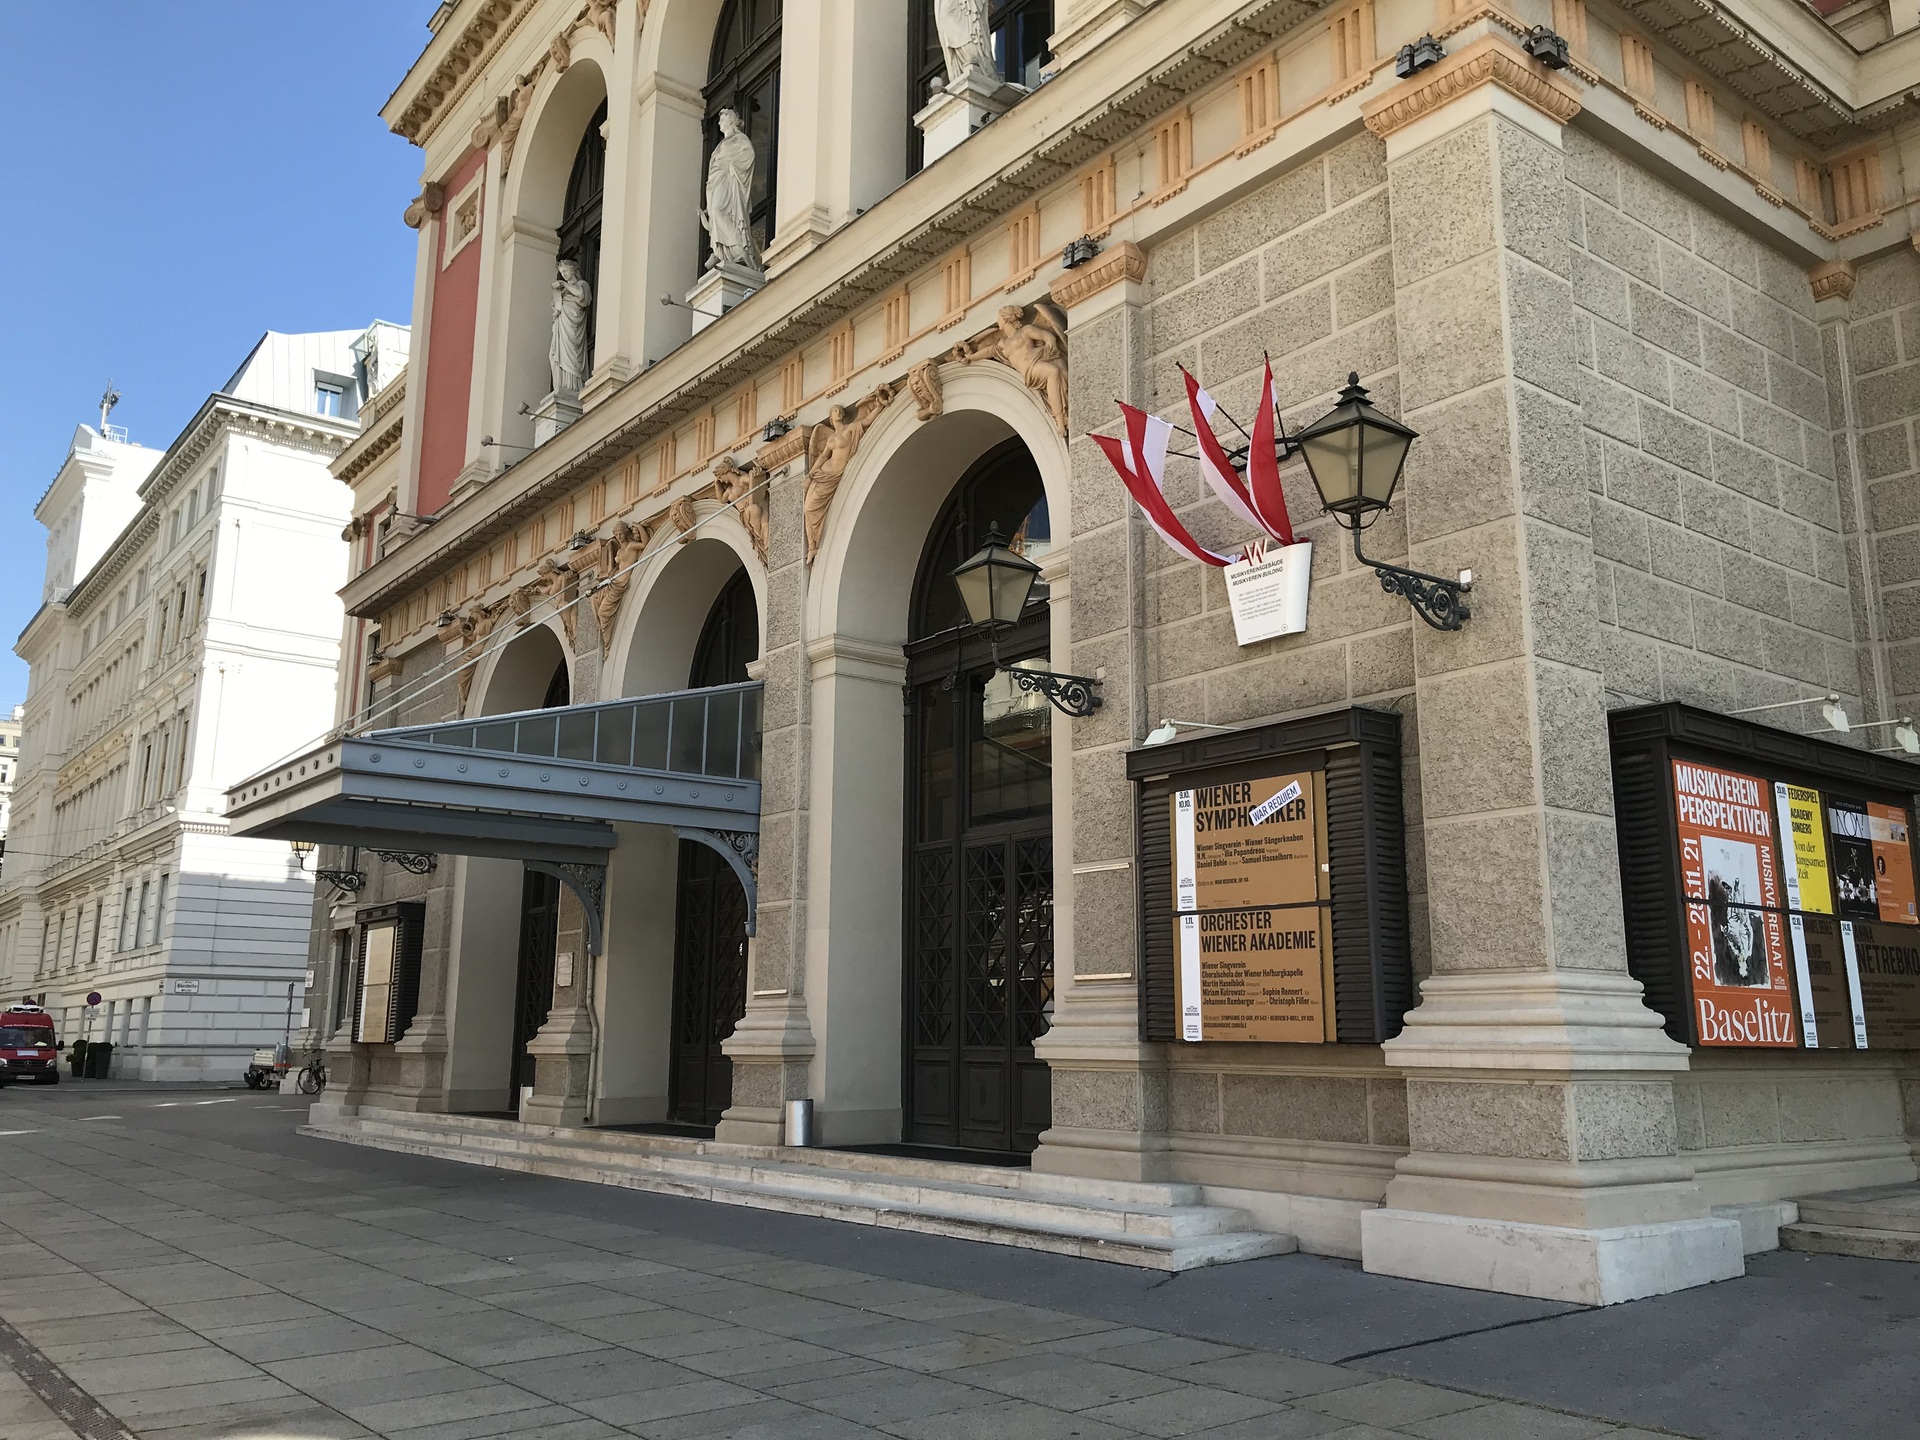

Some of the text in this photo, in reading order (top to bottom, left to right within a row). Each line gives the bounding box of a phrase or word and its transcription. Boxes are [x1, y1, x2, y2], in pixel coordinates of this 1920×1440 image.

[1232, 566, 1283, 586] MUSIKVEREIN BUILDING
[1196, 782, 1251, 809] WIENER
[1676, 764, 1759, 807] MUSIKVEREIN
[1252, 785, 1298, 822] WAR REQUIEM
[1788, 788, 1818, 804] FEDERSPIEL
[1196, 799, 1306, 832] SYMPHKER
[1679, 794, 1770, 837] PERSPEKTIVEN
[1791, 808, 1812, 821] ACADEMY
[1792, 822, 1812, 834] SINGERS
[1215, 841, 1241, 851] Singverein
[1264, 834, 1303, 845] Sängerknaben
[1234, 848, 1265, 857] Papandreou
[1197, 860, 1212, 868] Daniel
[1242, 856, 1261, 864] Samuel
[1262, 853, 1292, 862] Hasselhorn
[1760, 845, 1783, 970] MUSIKVEREIN.AT
[1201, 911, 1271, 932] ORCHESTER
[1201, 930, 1316, 953] WIENER AKADEMIE
[1854, 924, 1874, 943] ANNA
[1220, 961, 1246, 970] Singverein
[1694, 946, 1711, 980] 22.
[1856, 944, 1920, 976] NETREBKO
[1263, 968, 1303, 978] Hofburgkapelle
[1262, 988, 1280, 997] Sophie
[1269, 997, 1295, 1006] Christoph
[1698, 997, 1794, 1043] Baselitz
